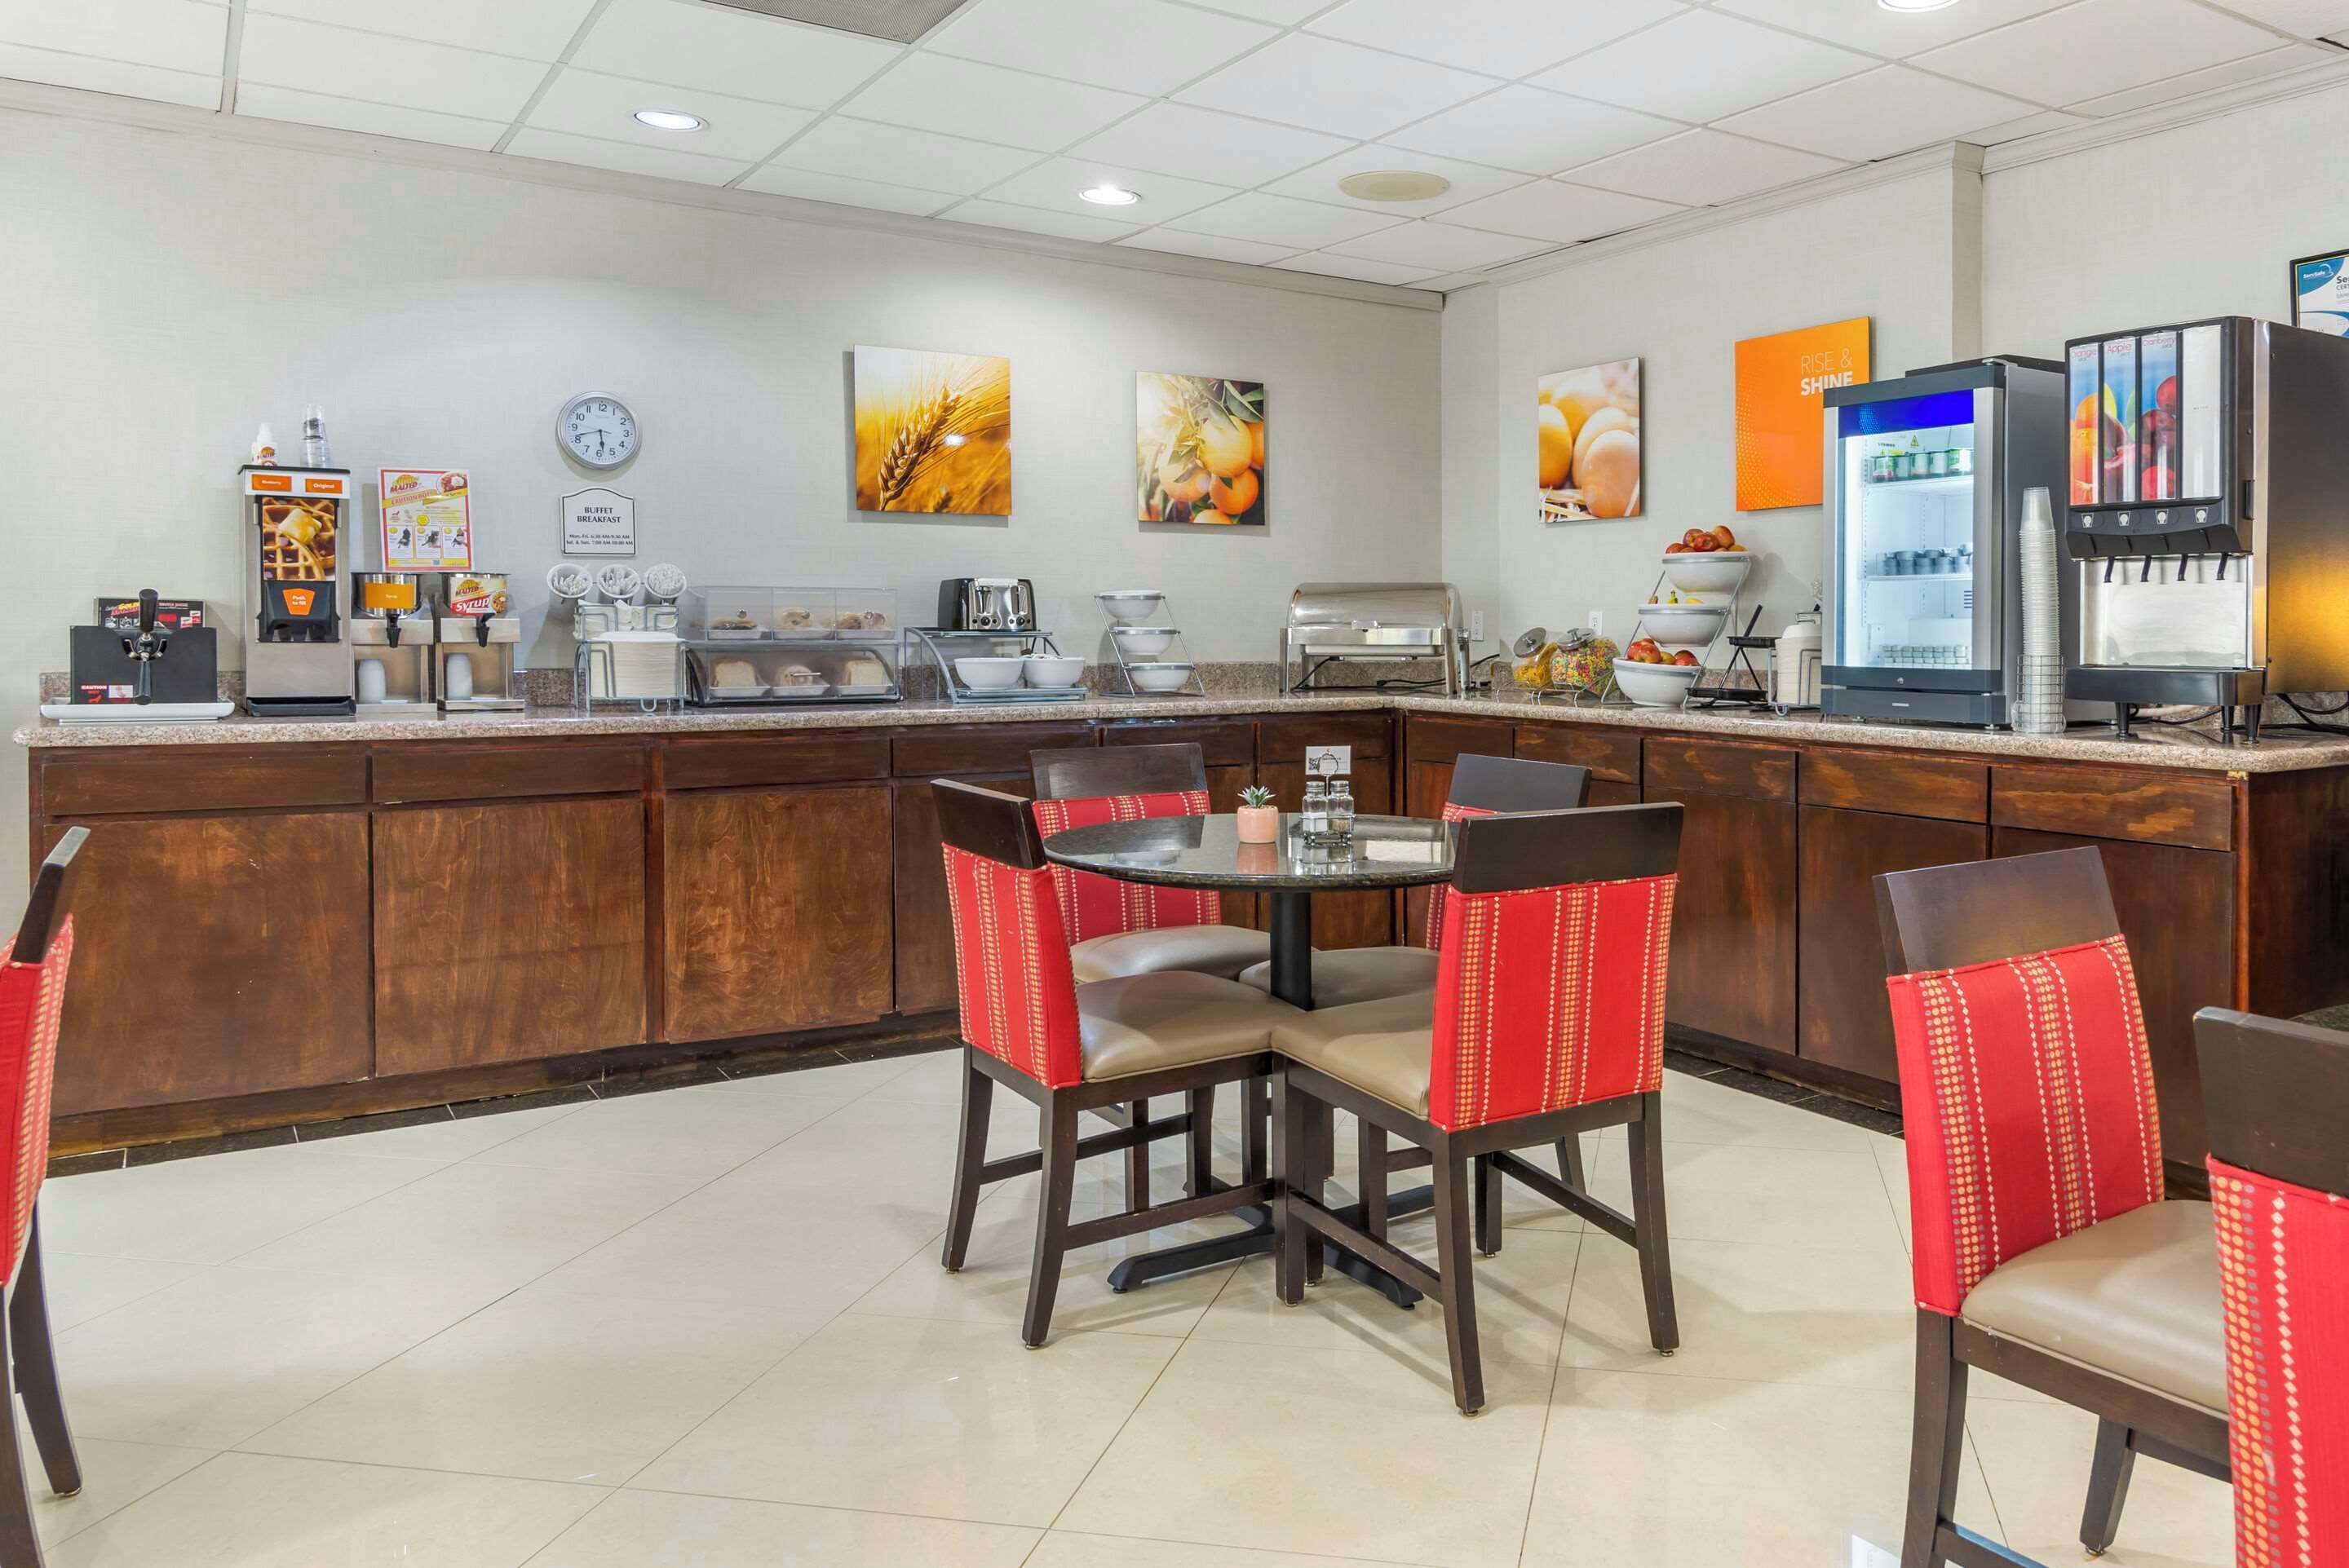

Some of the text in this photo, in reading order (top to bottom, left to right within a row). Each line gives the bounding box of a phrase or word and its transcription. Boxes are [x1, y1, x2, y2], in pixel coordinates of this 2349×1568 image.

[2336, 276, 2349, 284] Se
[2107, 343, 2132, 353] Apple
[1801, 347, 1852, 375] RISE &
[1800, 371, 1853, 396] SHINE
[586, 404, 591, 413] 11
[599, 403, 608, 413] 12
[576, 412, 586, 422] 10
[620, 417, 627, 425] 2
[571, 422, 578, 431] 9
[622, 429, 630, 438] 3
[574, 435, 582, 444] 8
[618, 440, 625, 448] 4
[584, 444, 591, 453] 7
[595, 449, 603, 457] 6
[609, 447, 616, 456] 5
[584, 506, 613, 515] BUFFET
[577, 515, 622, 523] BREAKFAST
[455, 597, 490, 612] Syrup
